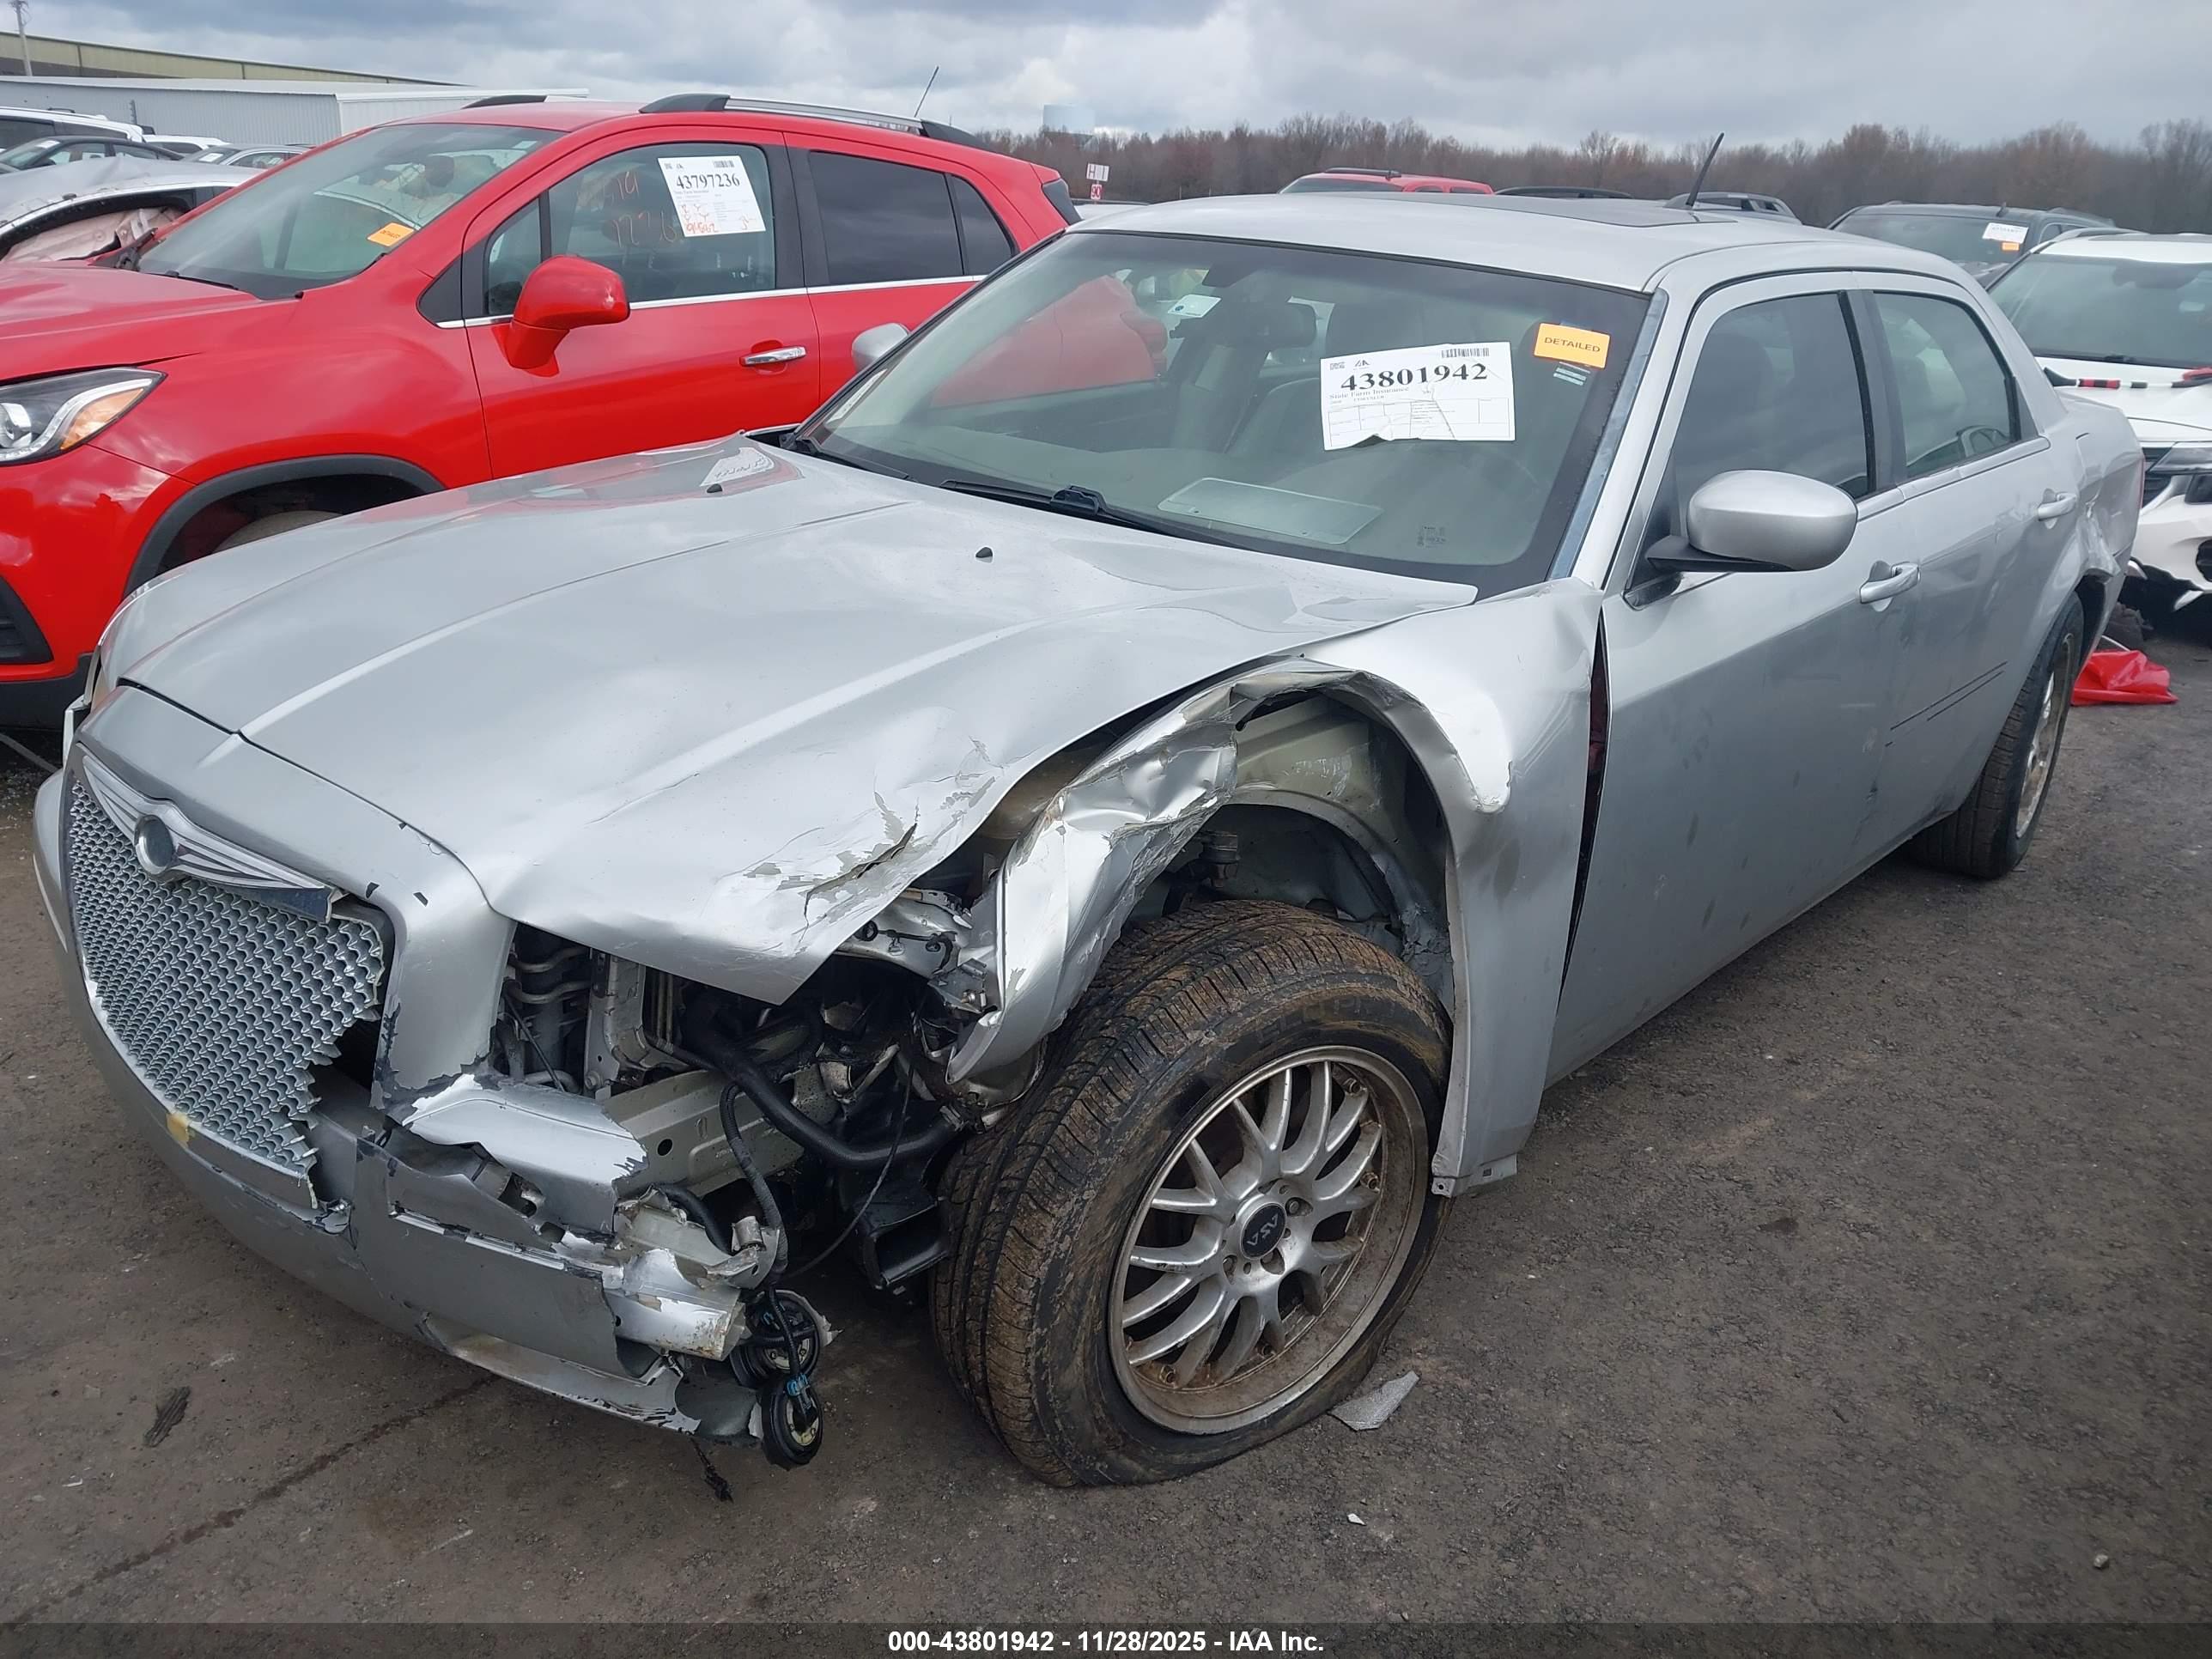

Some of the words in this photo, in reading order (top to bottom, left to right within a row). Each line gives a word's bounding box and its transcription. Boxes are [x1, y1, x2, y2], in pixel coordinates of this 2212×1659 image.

[677, 173, 740, 190] 43797236
[1544, 337, 1601, 352] DETAILED
[1340, 363, 1488, 391] 43801942
